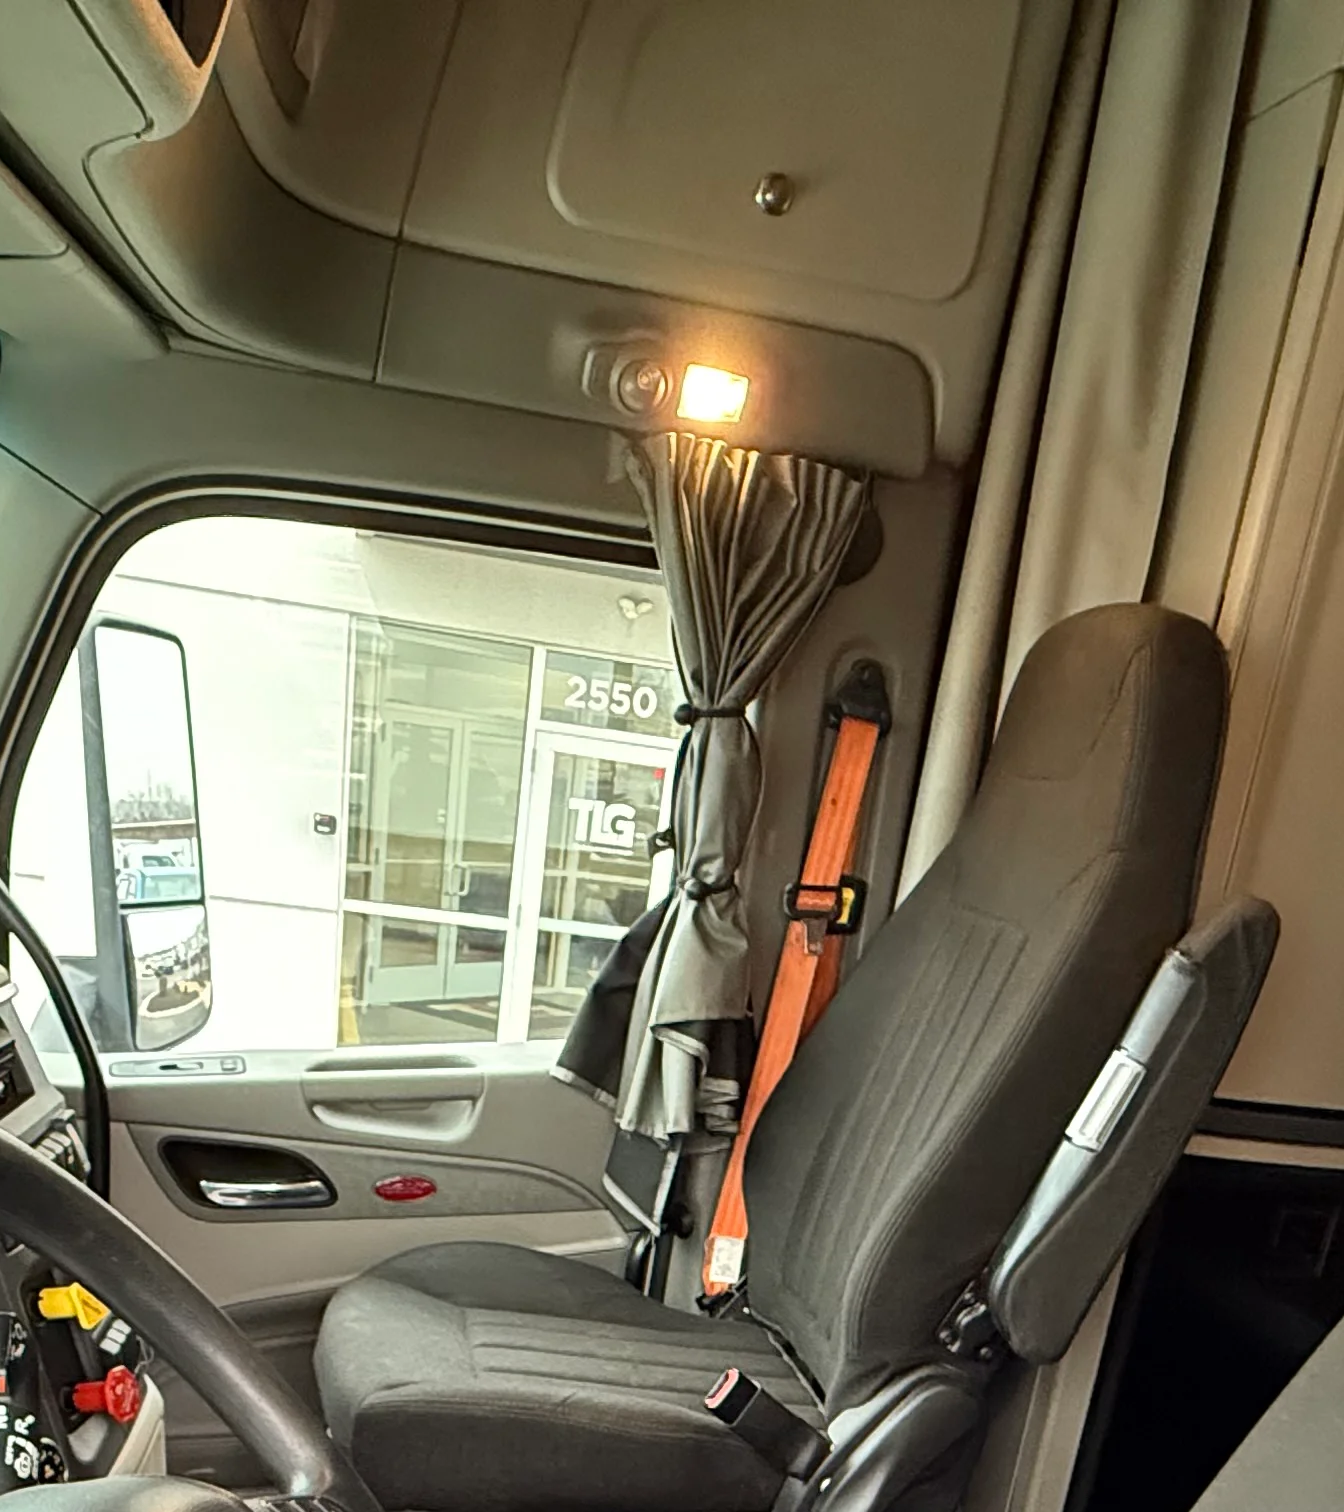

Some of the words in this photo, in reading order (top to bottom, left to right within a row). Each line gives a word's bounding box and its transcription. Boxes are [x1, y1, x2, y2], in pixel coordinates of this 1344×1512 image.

[564, 675, 658, 719] 2550
[567, 797, 637, 850] TLG
[14, 1418, 30, 1435] R
